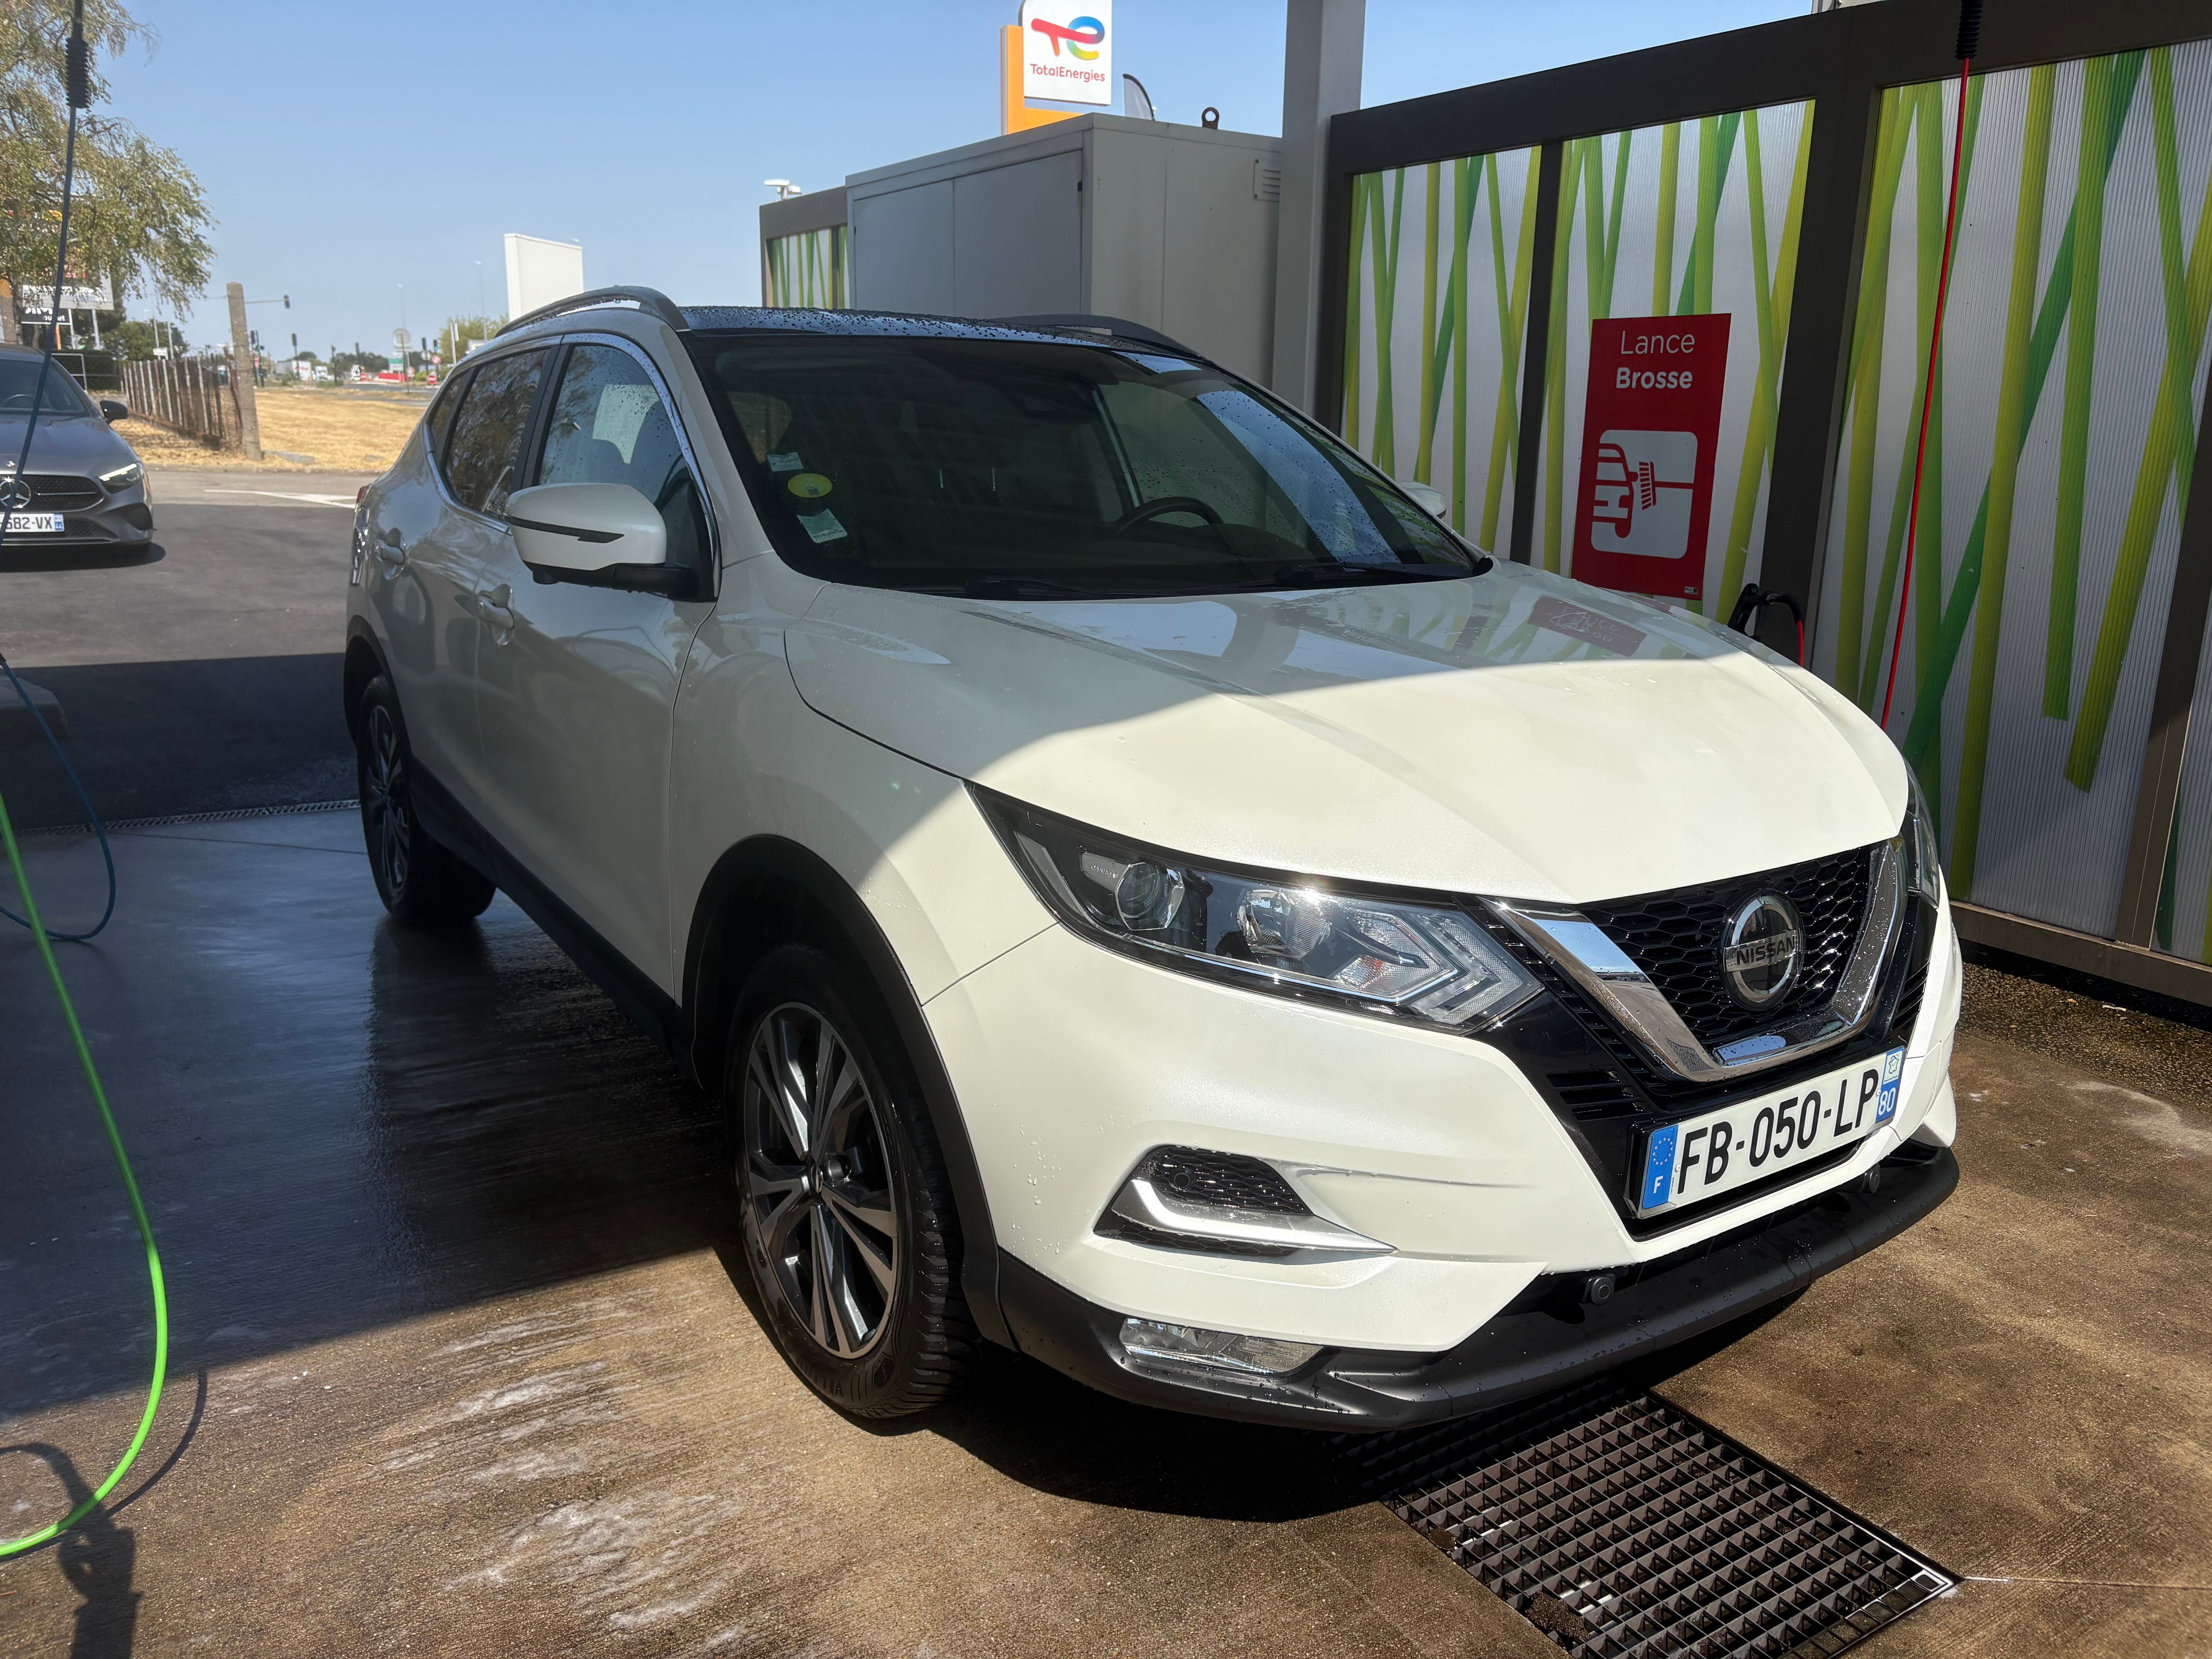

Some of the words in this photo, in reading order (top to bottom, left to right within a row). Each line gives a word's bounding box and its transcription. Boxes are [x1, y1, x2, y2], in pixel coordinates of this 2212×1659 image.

[1030, 64, 1105, 82] TotalEnergies
[1621, 330, 1695, 354] Lance
[1616, 367, 1693, 389] Brosse
[1736, 936, 1795, 965] NISSAN
[1878, 1087, 1896, 1116] 80
[1677, 1069, 1879, 1195] FB-050-LP
[1653, 1175, 1664, 1194] F
